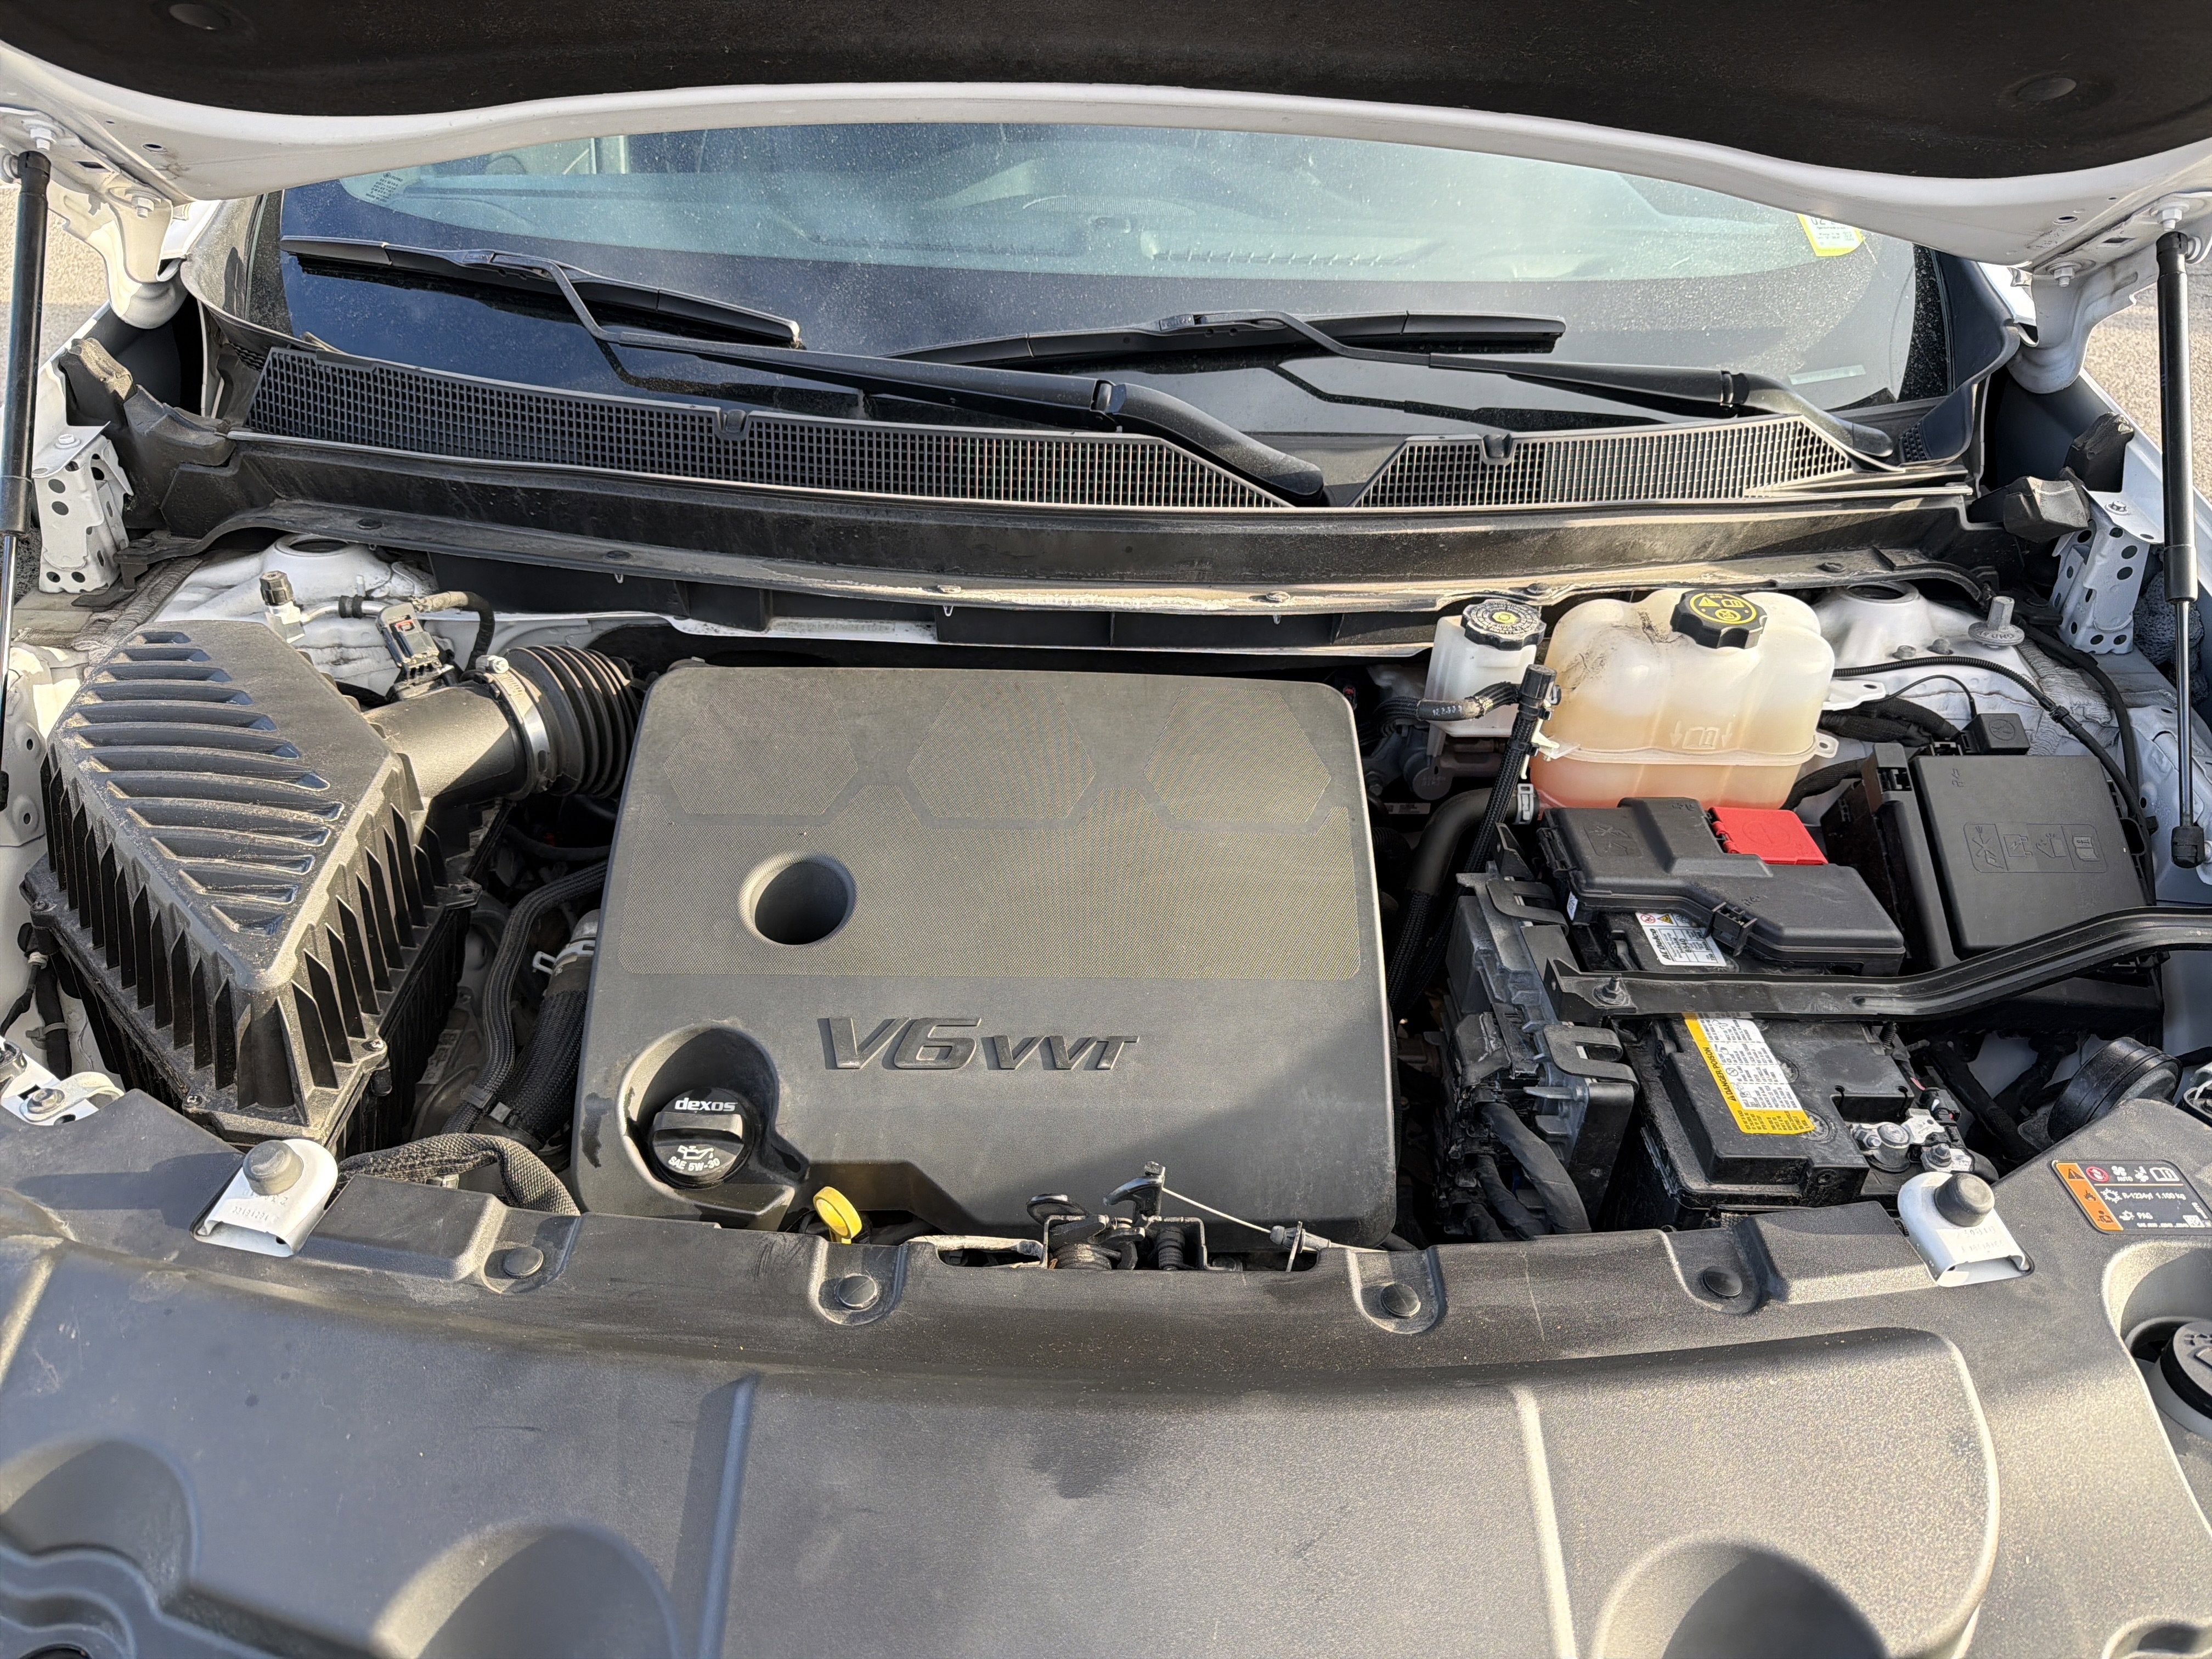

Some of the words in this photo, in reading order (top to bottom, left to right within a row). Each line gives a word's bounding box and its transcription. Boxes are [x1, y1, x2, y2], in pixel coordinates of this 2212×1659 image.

[1650, 928, 1671, 960] ACDelco
[823, 1017, 982, 1070] V6
[988, 1035, 1140, 1070] VVT
[1703, 1047, 1734, 1098] DANGER/POISON
[675, 1097, 736, 1111] dexos
[668, 1156, 685, 1170] SAE
[688, 1158, 720, 1171] 5W-30
